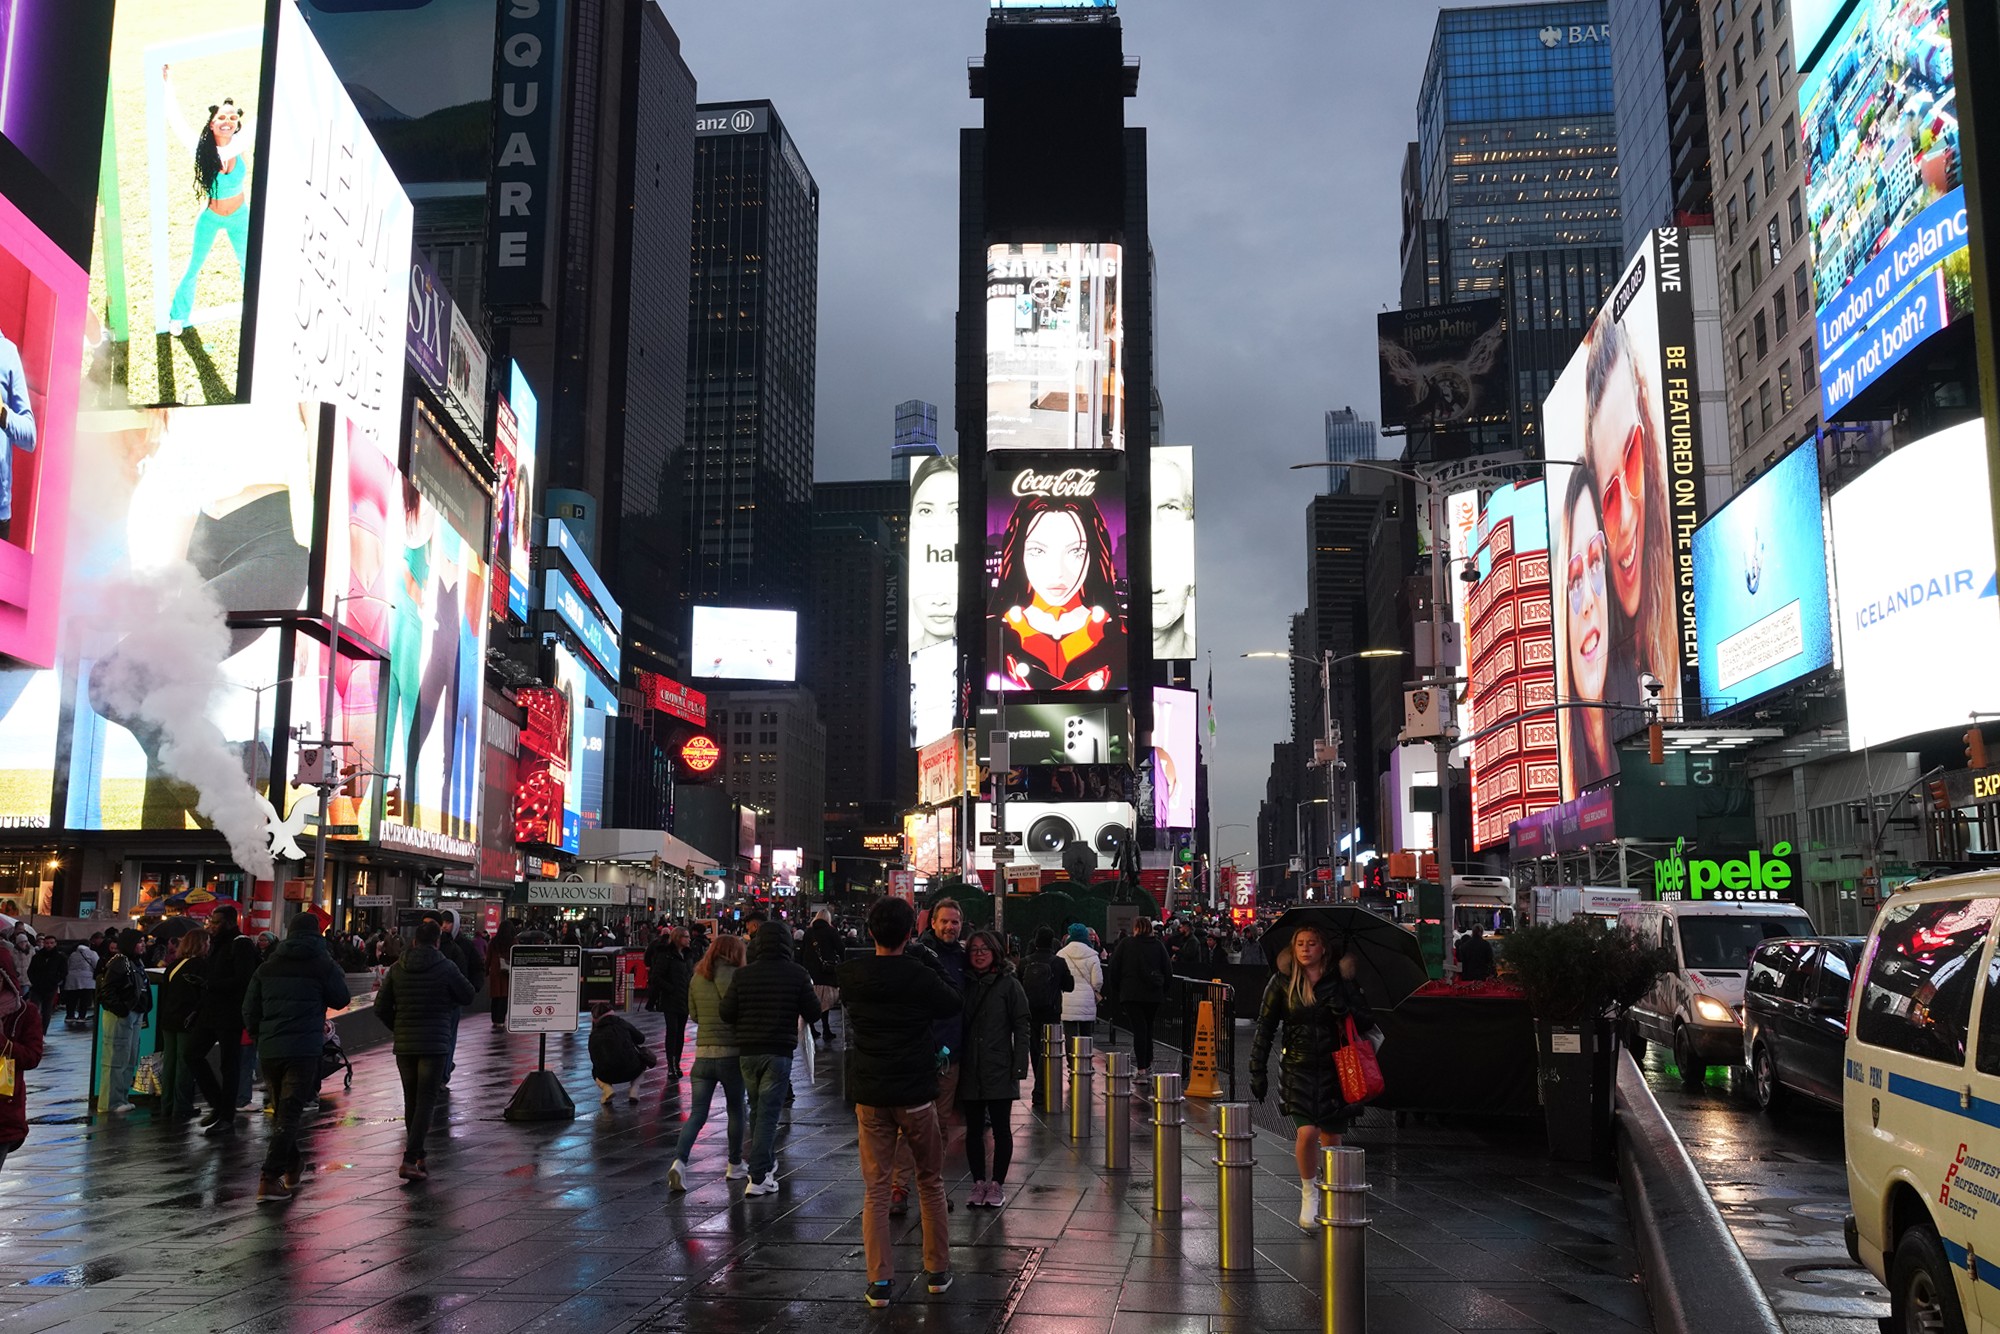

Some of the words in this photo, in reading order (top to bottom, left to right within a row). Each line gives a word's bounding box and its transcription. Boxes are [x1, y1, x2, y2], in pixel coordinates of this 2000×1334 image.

[993, 257, 1116, 279] SAMSUNG
[409, 264, 445, 367] SIX
[1405, 312, 1420, 321] ON
[1423, 305, 1473, 319] BROADWAY
[1823, 286, 1873, 350] London
[1876, 265, 1892, 299] or
[1403, 324, 1439, 347] Harry
[1440, 318, 1478, 340] Potter
[1665, 346, 1687, 370] BE
[1827, 362, 1855, 405] why
[1857, 339, 1881, 382] not
[1882, 296, 1927, 361] both?
[1668, 377, 1694, 475] FEATURED
[1674, 480, 1696, 506] ON
[1676, 511, 1697, 549] THE
[1856, 568, 1974, 631] ICELANDAIR
[693, 739, 709, 747] HOT
[1974, 773, 2000, 798] EXP
[1654, 836, 1685, 902] pelé
[1689, 841, 1792, 900] pelé
[530, 886, 611, 899] SWAROVSKI
[1662, 891, 1681, 901] SOCCER
[1714, 890, 1779, 900] SOCCER
[1939, 1183, 1979, 1220] RESPECT
